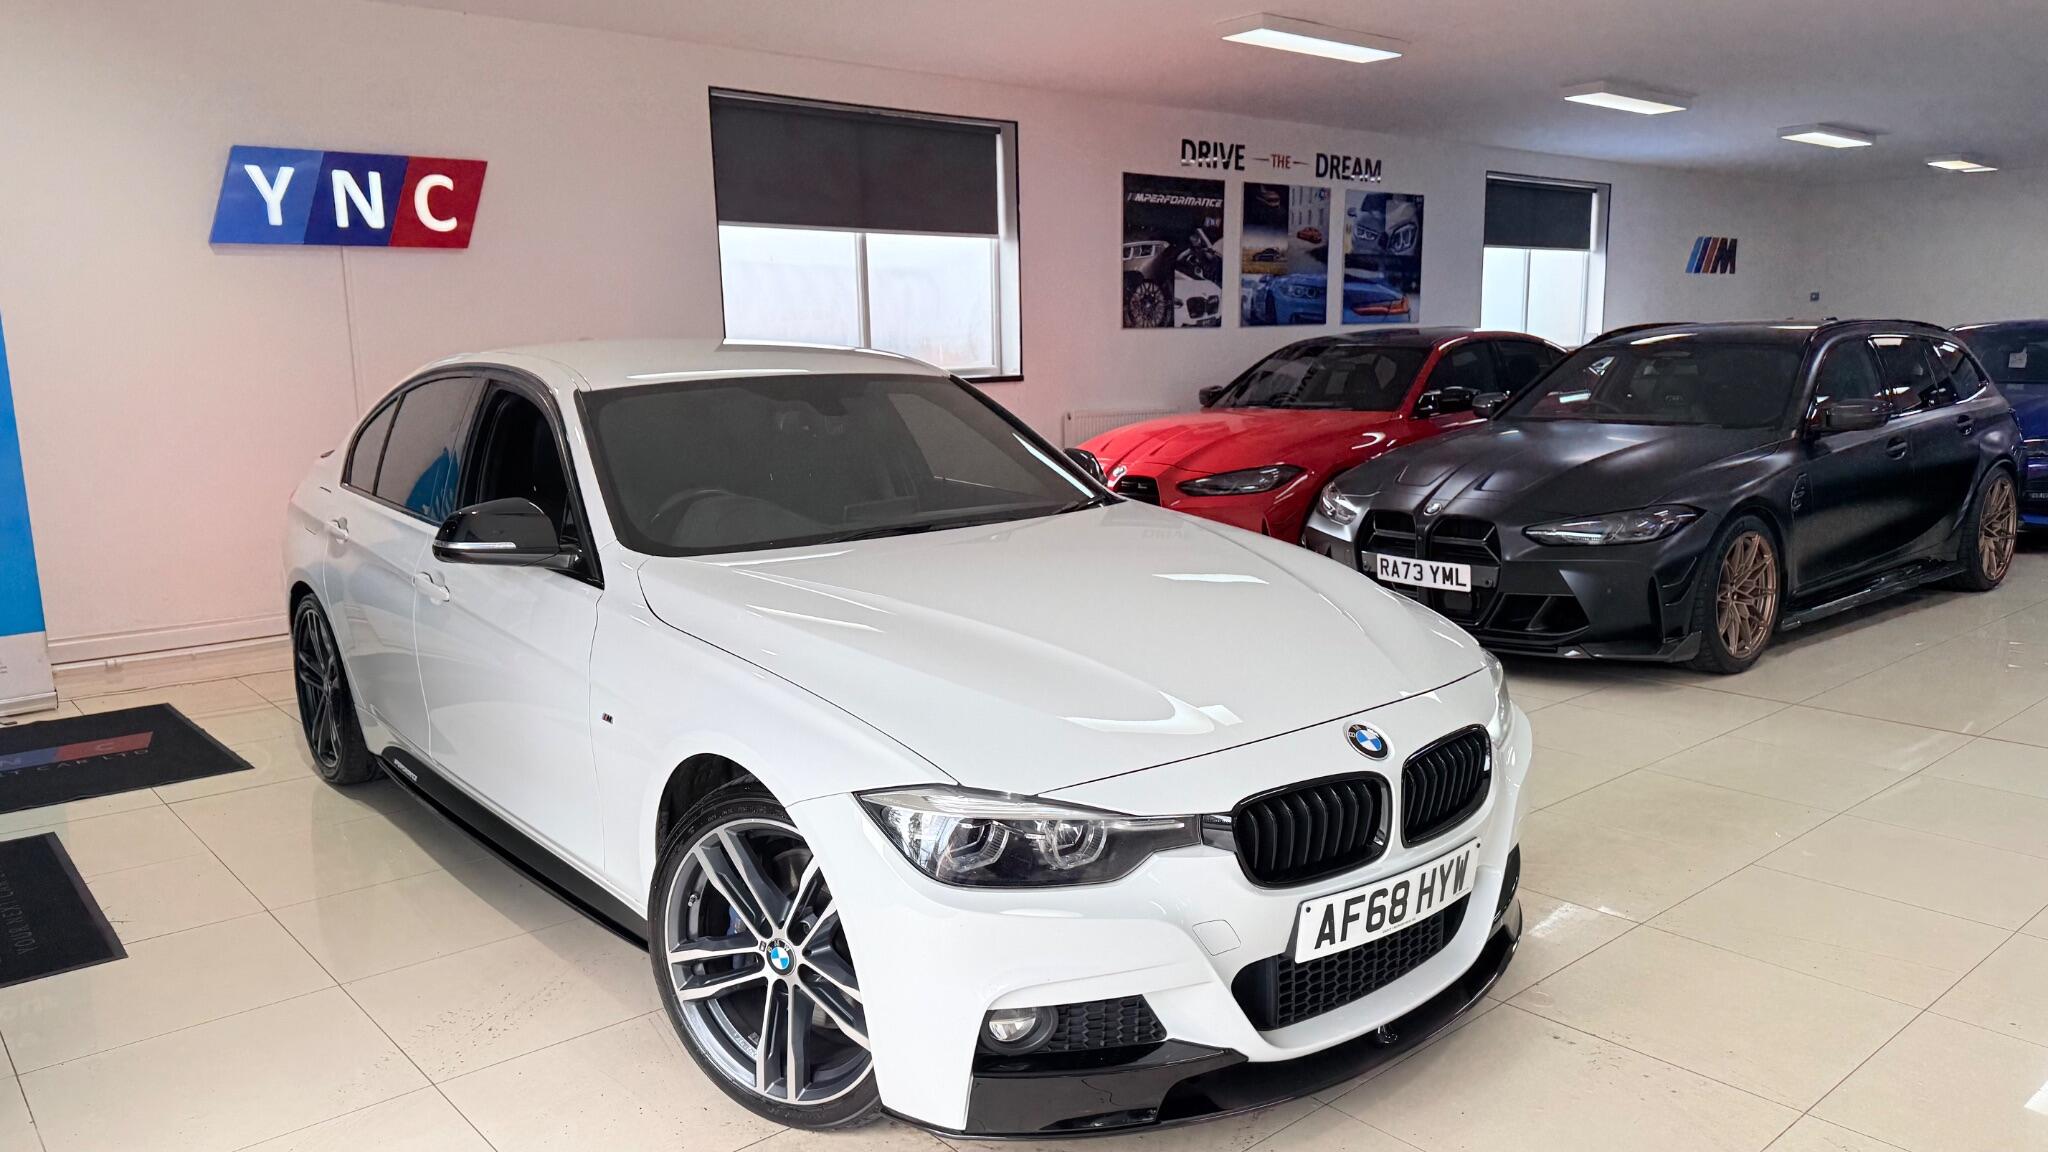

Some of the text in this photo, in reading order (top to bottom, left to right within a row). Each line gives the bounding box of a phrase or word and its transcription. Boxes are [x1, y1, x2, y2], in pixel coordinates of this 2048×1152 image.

[1181, 138, 1382, 183] DRIVE THE DREAM
[244, 164, 458, 232] YNC
[1380, 557, 1467, 587] RA73 YML
[1314, 850, 1470, 949] AF68 HYW
